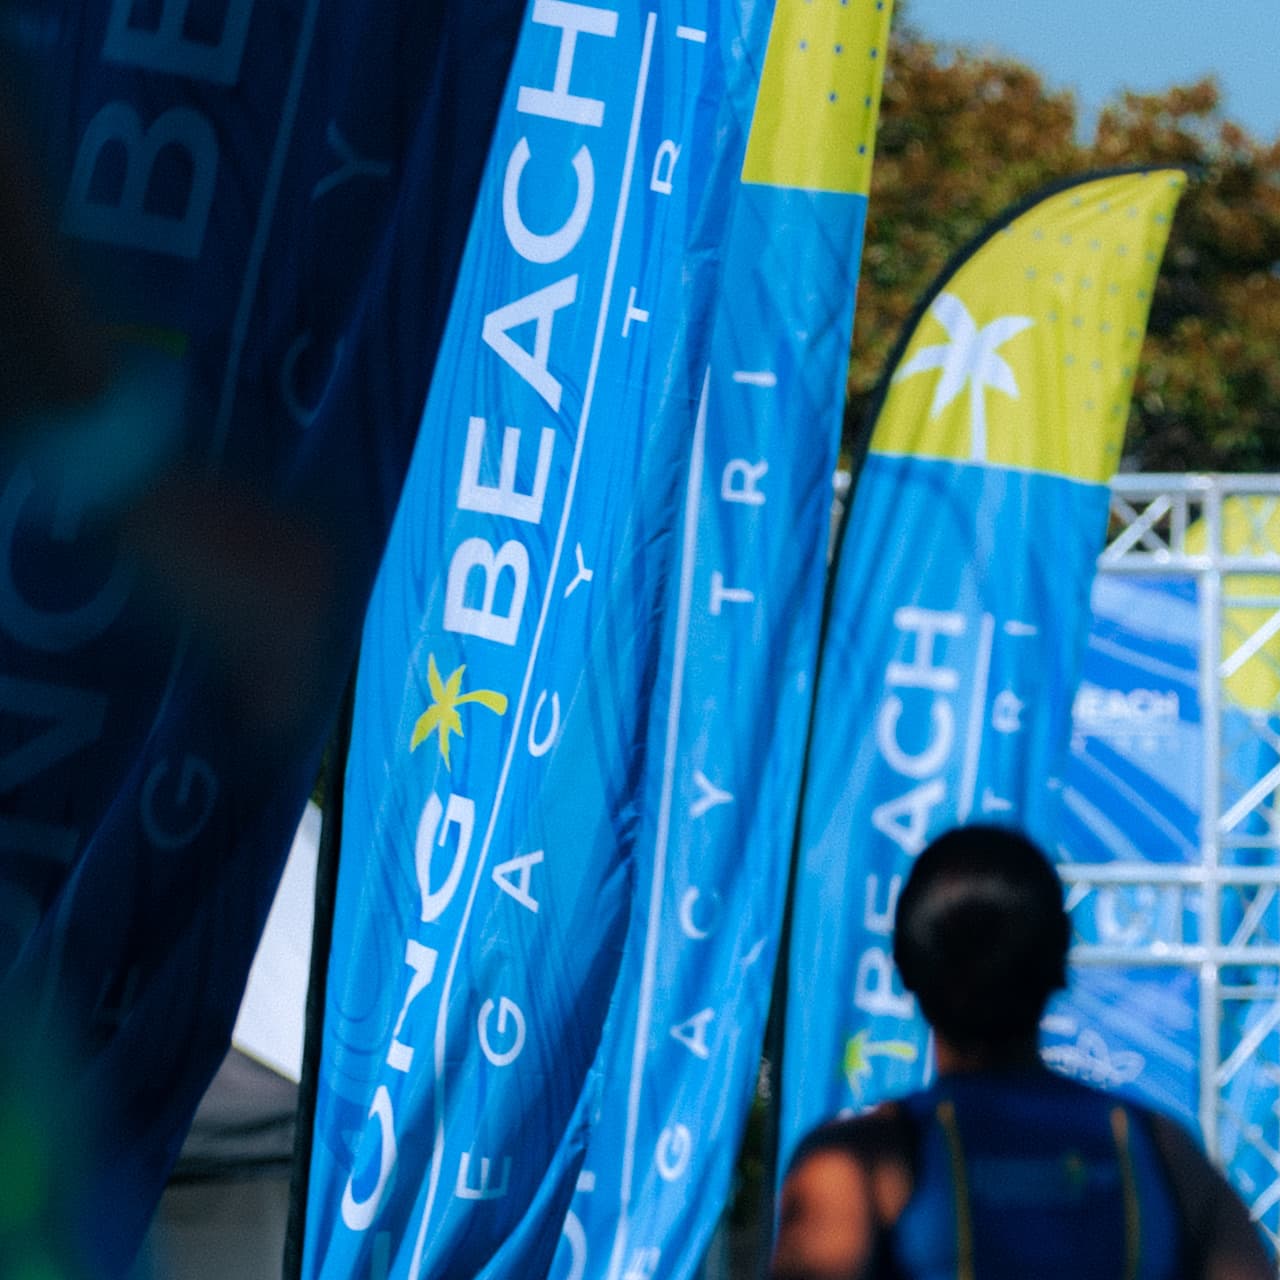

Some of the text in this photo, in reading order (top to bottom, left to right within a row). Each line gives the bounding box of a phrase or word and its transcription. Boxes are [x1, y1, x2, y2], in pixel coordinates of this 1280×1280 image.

[443, 0, 620, 647] BEACH
[621, 26, 708, 338] TRI
[708, 371, 778, 615] TRI
